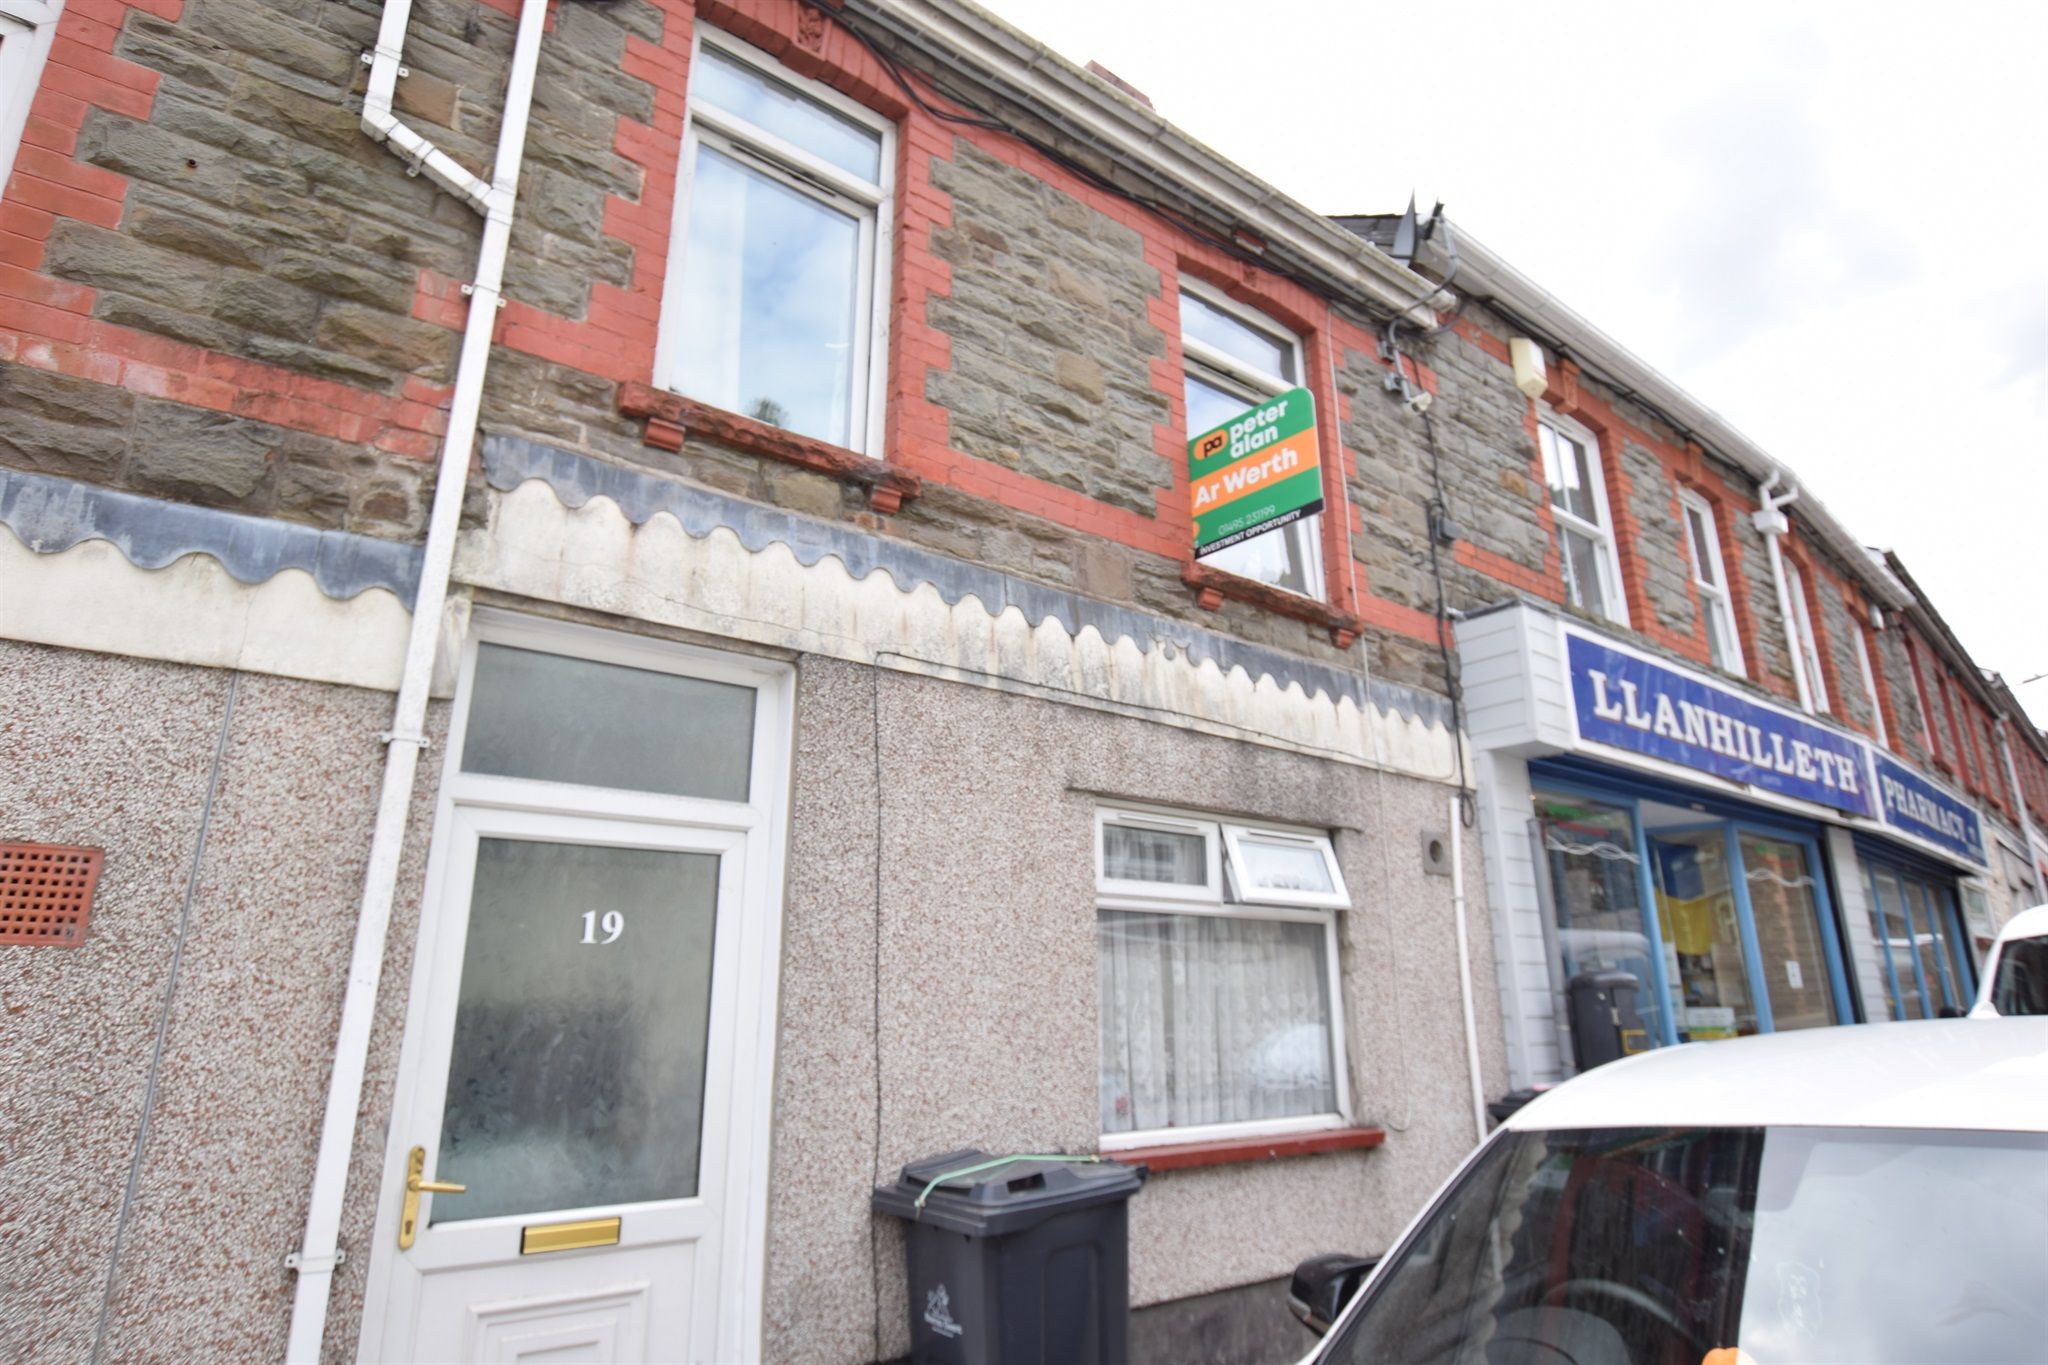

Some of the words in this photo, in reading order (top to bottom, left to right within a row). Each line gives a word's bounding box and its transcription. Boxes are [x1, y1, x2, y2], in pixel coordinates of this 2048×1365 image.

[1229, 400, 1288, 444] peter
[1229, 425, 1279, 459] alan
[1203, 435, 1223, 458] pa
[1194, 484, 1221, 509] Ar
[1222, 448, 1299, 494] Werth
[1200, 531, 1245, 555] INVESTMENT
[1245, 509, 1302, 537] OPPORTUNITY
[1587, 668, 1860, 795] LLANHILLETH
[1880, 774, 1968, 844] PHARMACY
[579, 909, 625, 945] 19
